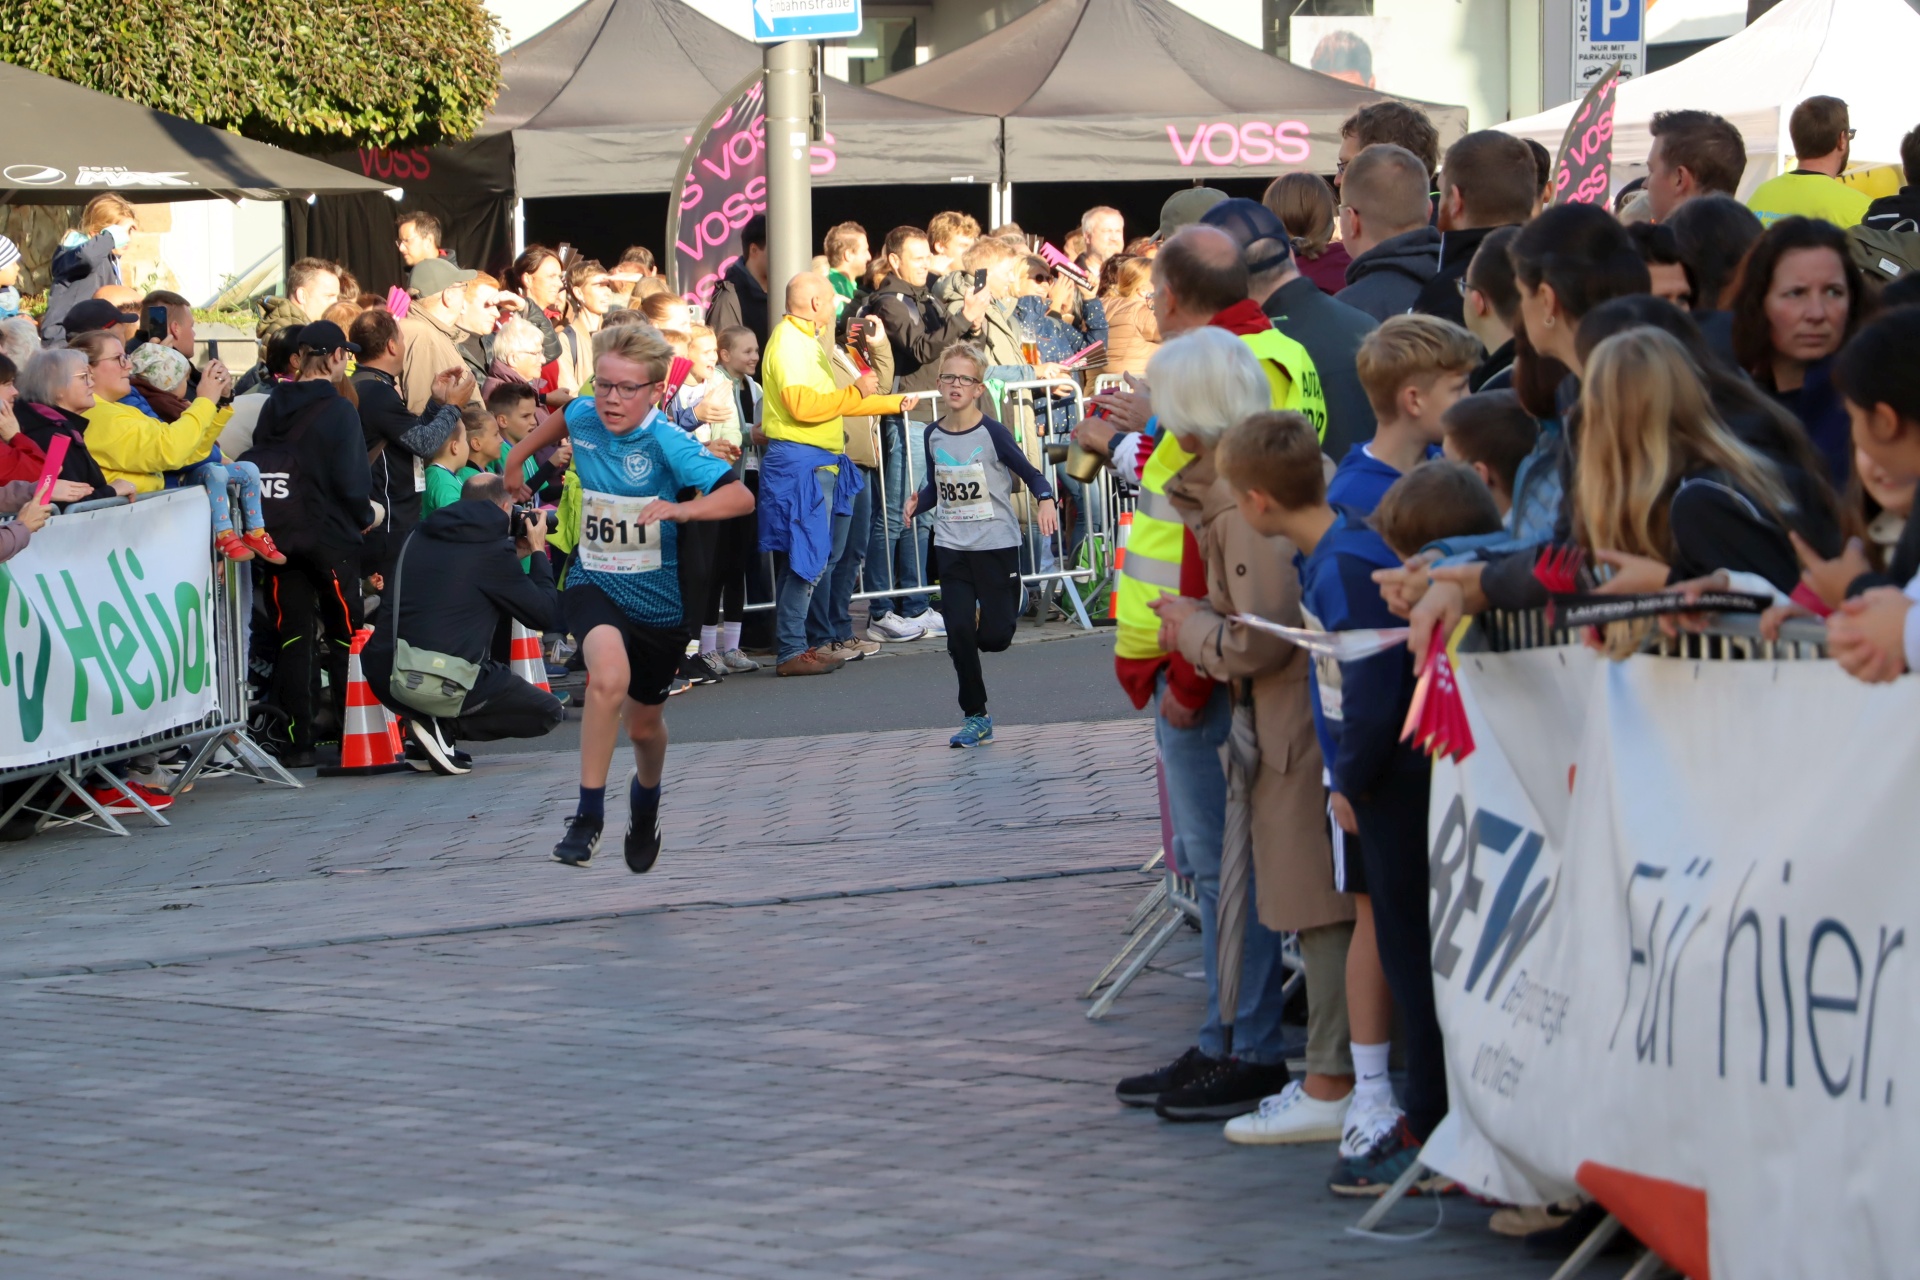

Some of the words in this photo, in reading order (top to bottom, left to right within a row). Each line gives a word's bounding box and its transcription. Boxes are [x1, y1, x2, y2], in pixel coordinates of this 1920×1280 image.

[1602, 0, 1630, 36] P
[359, 146, 431, 179] VOSS
[1166, 121, 1310, 166] VOSS
[940, 481, 983, 501] 5832
[586, 515, 647, 544] 5611
[35, 547, 211, 722] Helio
[1430, 793, 1561, 1002] BEW
[1718, 860, 1905, 1107] hier.
